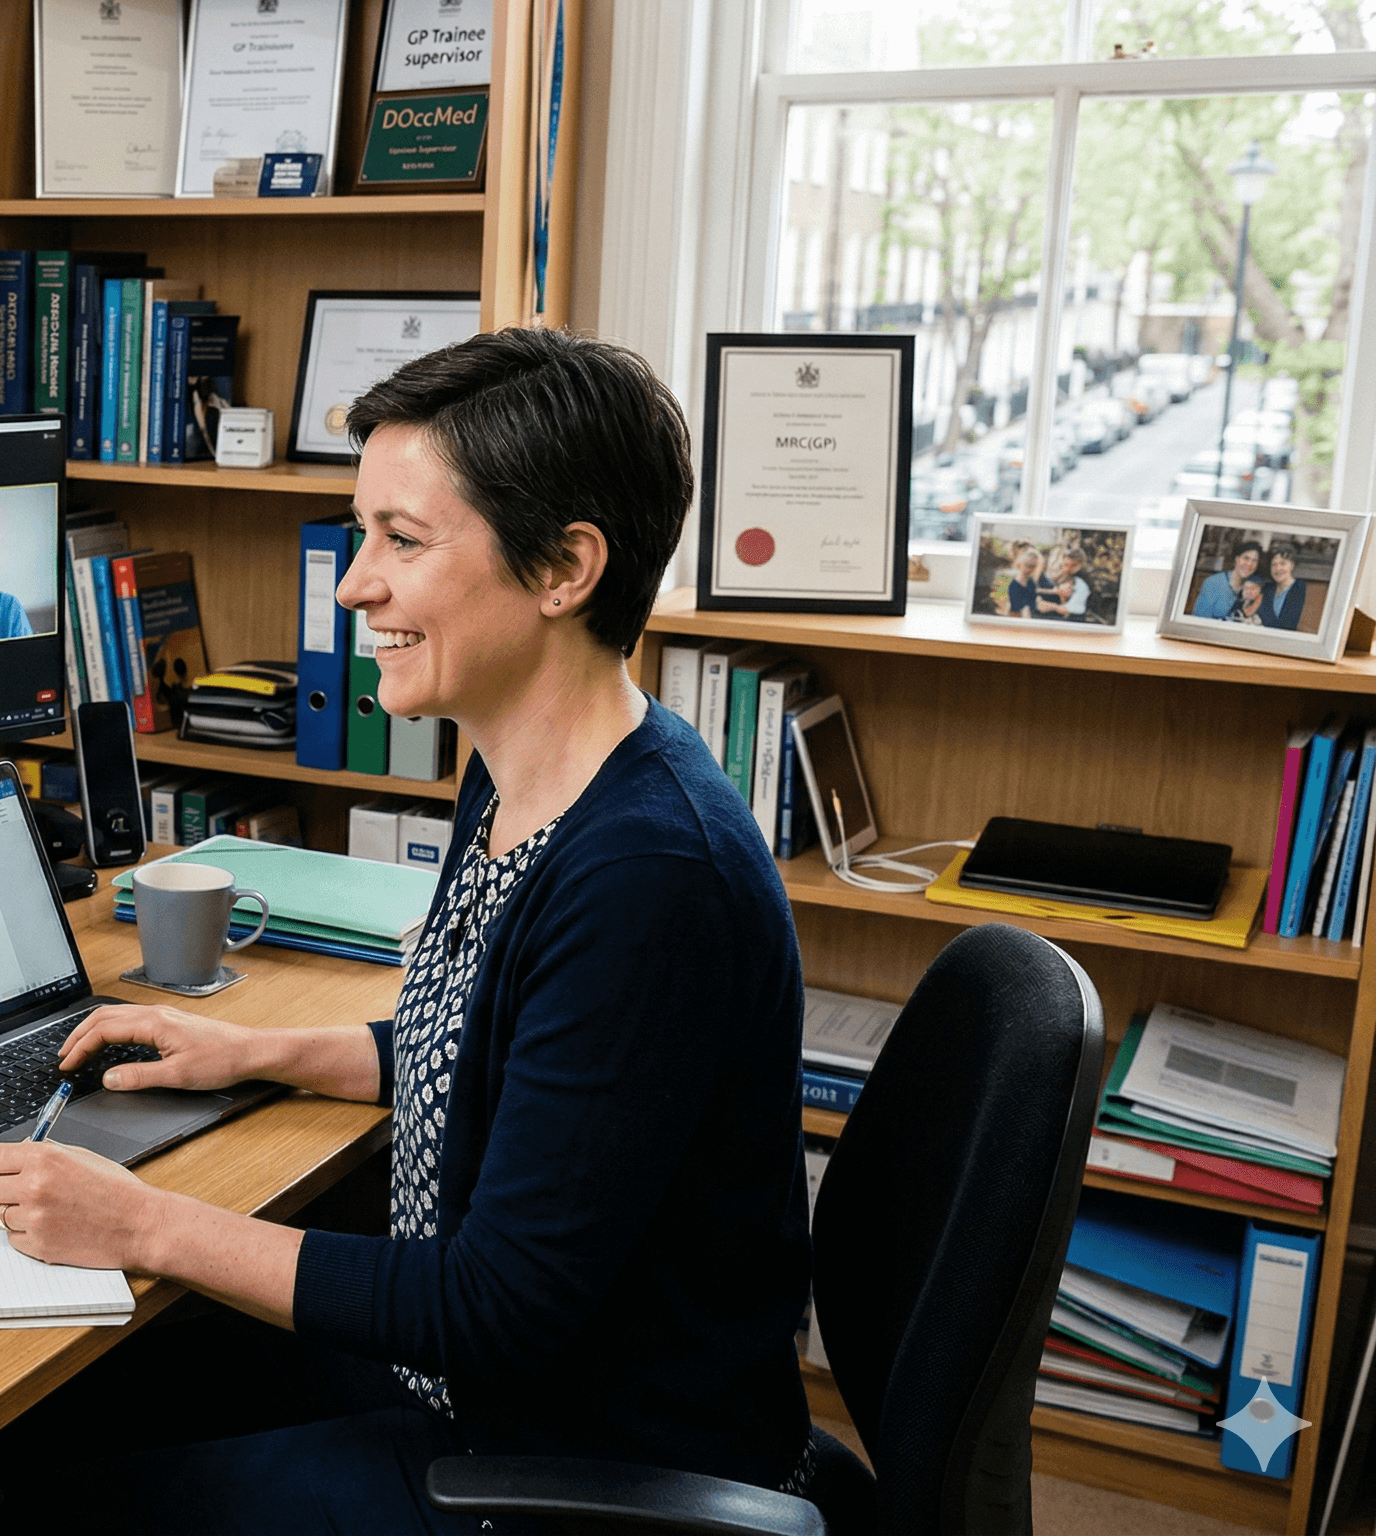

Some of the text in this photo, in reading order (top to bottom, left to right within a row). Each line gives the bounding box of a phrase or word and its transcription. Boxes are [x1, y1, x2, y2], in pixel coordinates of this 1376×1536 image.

[408, 26, 486, 45] GP Trainee
[404, 46, 483, 69] supervisor
[382, 103, 479, 130] DOccMed
[775, 437, 837, 451] MRC(GP)
